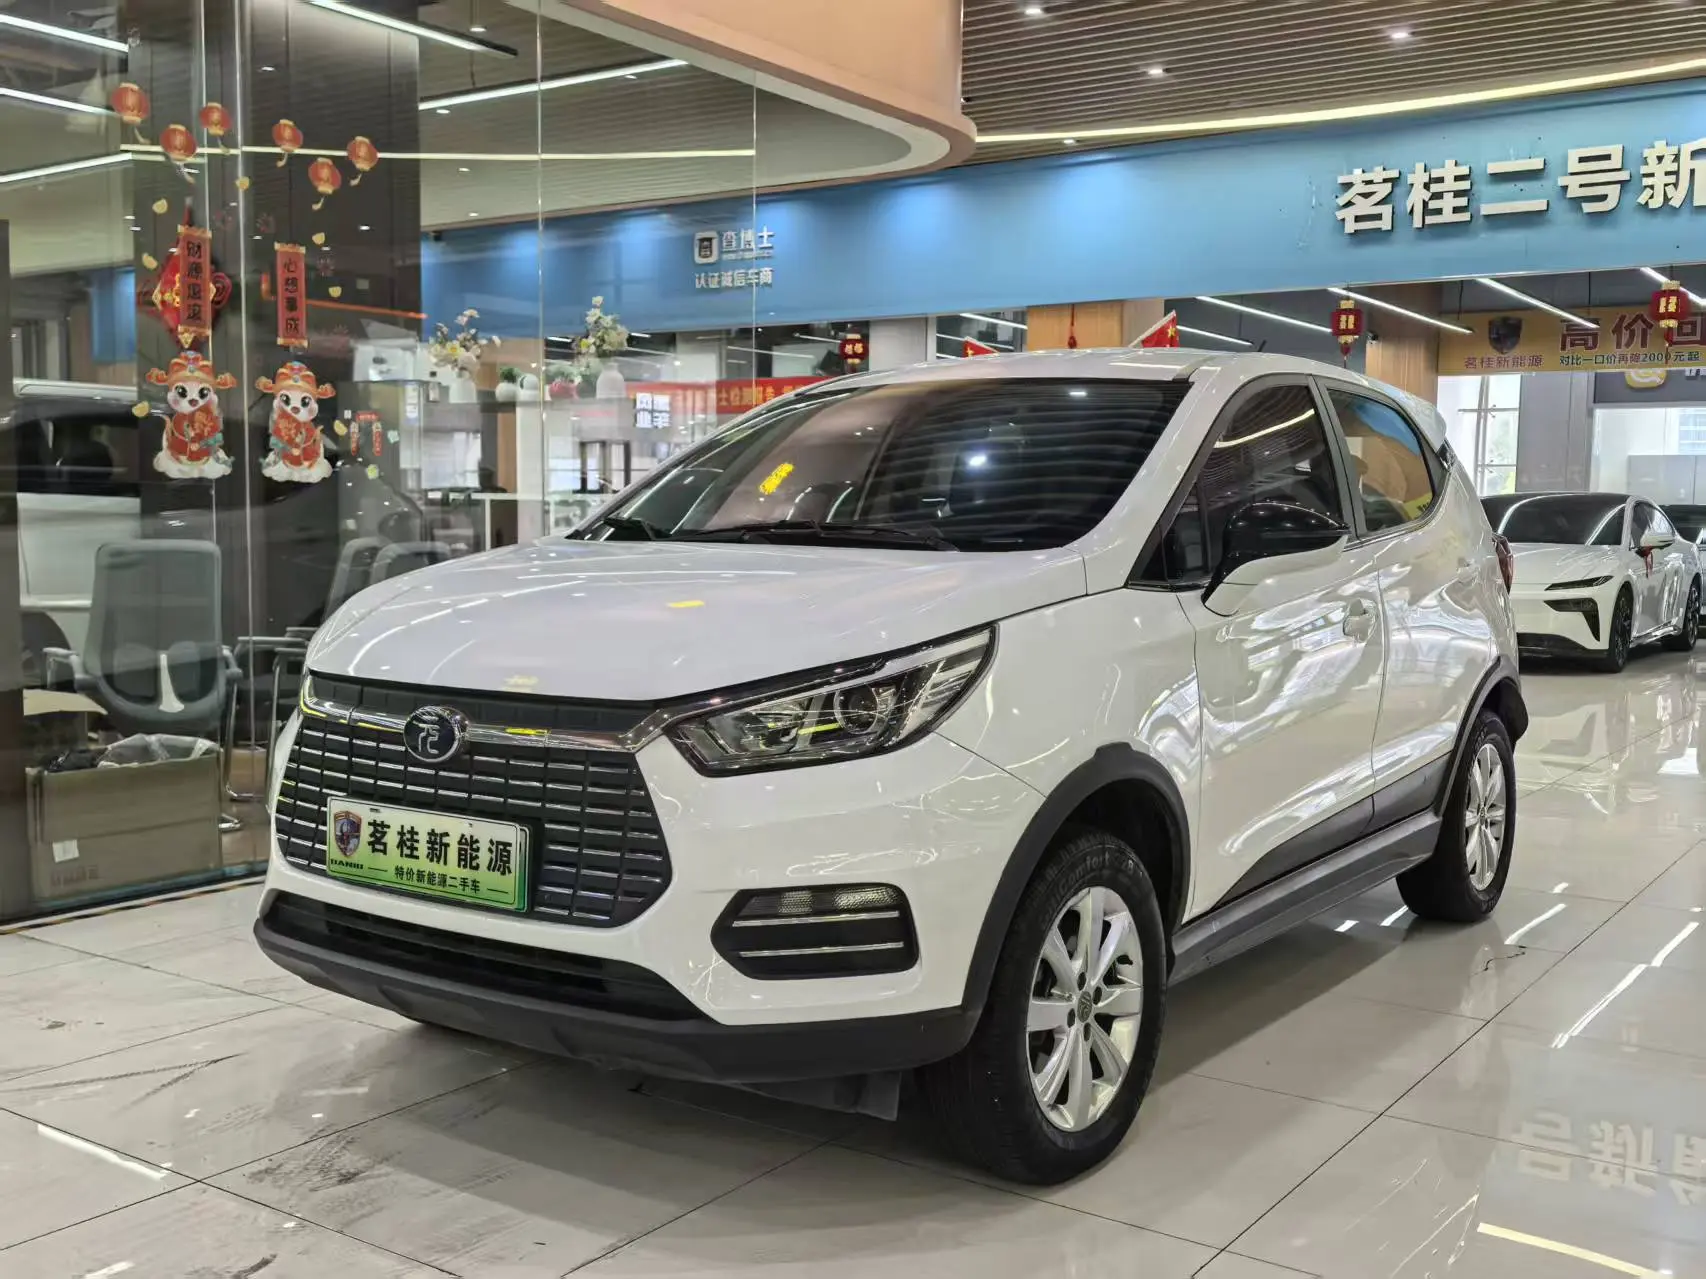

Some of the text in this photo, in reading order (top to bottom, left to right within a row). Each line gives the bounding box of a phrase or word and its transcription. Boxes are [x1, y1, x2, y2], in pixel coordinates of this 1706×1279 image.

[1335, 139, 1706, 234] 茗桂二号新
[283, 258, 300, 334] 心想事成
[1464, 354, 1543, 369] 茗桂新能源
[367, 819, 513, 877] 茗桂新能源
[394, 865, 481, 894] 特价新能源二手车
